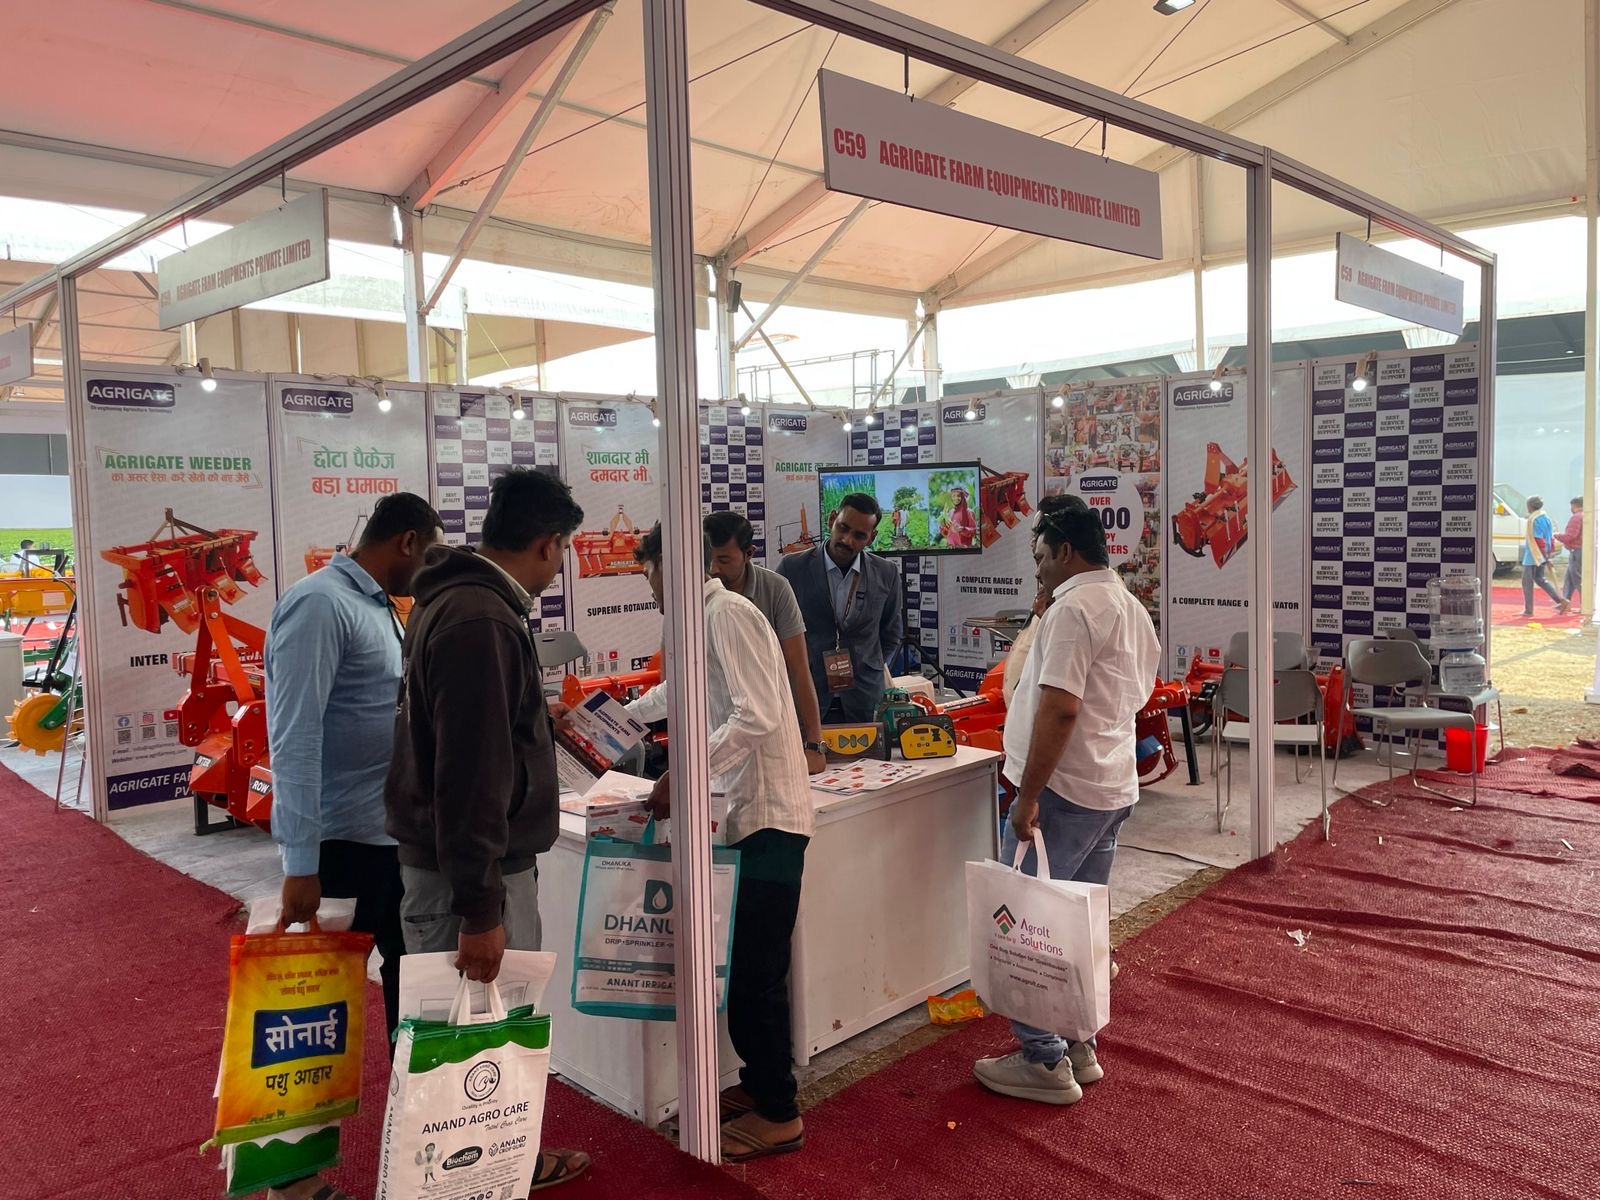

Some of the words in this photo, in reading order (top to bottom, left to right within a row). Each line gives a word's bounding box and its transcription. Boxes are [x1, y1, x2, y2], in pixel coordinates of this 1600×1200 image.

[834, 128, 866, 160] C59
[880, 140, 946, 180] AGRIGATE
[950, 160, 984, 189] FARM
[987, 169, 1058, 208] EQUIPMENTS
[1060, 189, 1101, 218] PRIVATE
[1103, 200, 1140, 227] LIMITED
[202, 273, 216, 294] FARM
[217, 259, 254, 288] EQUIPMENTS
[255, 249, 282, 275] PRIVATE
[282, 239, 310, 265] LIMITED
[90, 386, 173, 401] AGRIGATE
[1176, 387, 1232, 401] AGRIGATE
[284, 394, 352, 408] AGRIGATE
[570, 412, 616, 422] AGRIGATE
[770, 418, 805, 427] AGRIGATE
[105, 455, 184, 469] AGRIGATE
[189, 456, 251, 470] WEEDER
[313, 446, 348, 468] छोटा
[353, 447, 395, 468] पैकेज
[586, 451, 632, 465] शानदार
[635, 449, 649, 464] भी
[590, 468, 630, 482] दमदार
[633, 465, 648, 481] भी
[776, 462, 812, 472] AGRIGATE
[312, 477, 341, 497] बड़ा
[1081, 480, 1117, 488] AGRIGATE
[1090, 497, 1110, 505] OVER
[1179, 598, 1214, 606] COMPLETE
[587, 605, 621, 616] SUPREME
[130, 654, 168, 667] INTER
[945, 670, 975, 679] AGRIGATE
[196, 756, 211, 767] INTER
[109, 775, 169, 794] AGRIGATE
[175, 786, 194, 797] PV
[252, 780, 269, 793] ROW
[1020, 934, 1063, 956] Solutions
[607, 978, 640, 987] ANANT
[642, 980, 675, 989] IRRIGA
[265, 1009, 338, 1053] सोनाई
[266, 1072, 289, 1096] पशु
[294, 1065, 333, 1085] आहार
[422, 1118, 466, 1134] ANAND
[469, 1110, 500, 1125] AGRO
[504, 1102, 528, 1117] CARE
[500, 1136, 526, 1148] ANAND
[447, 1152, 479, 1166] Biochem
